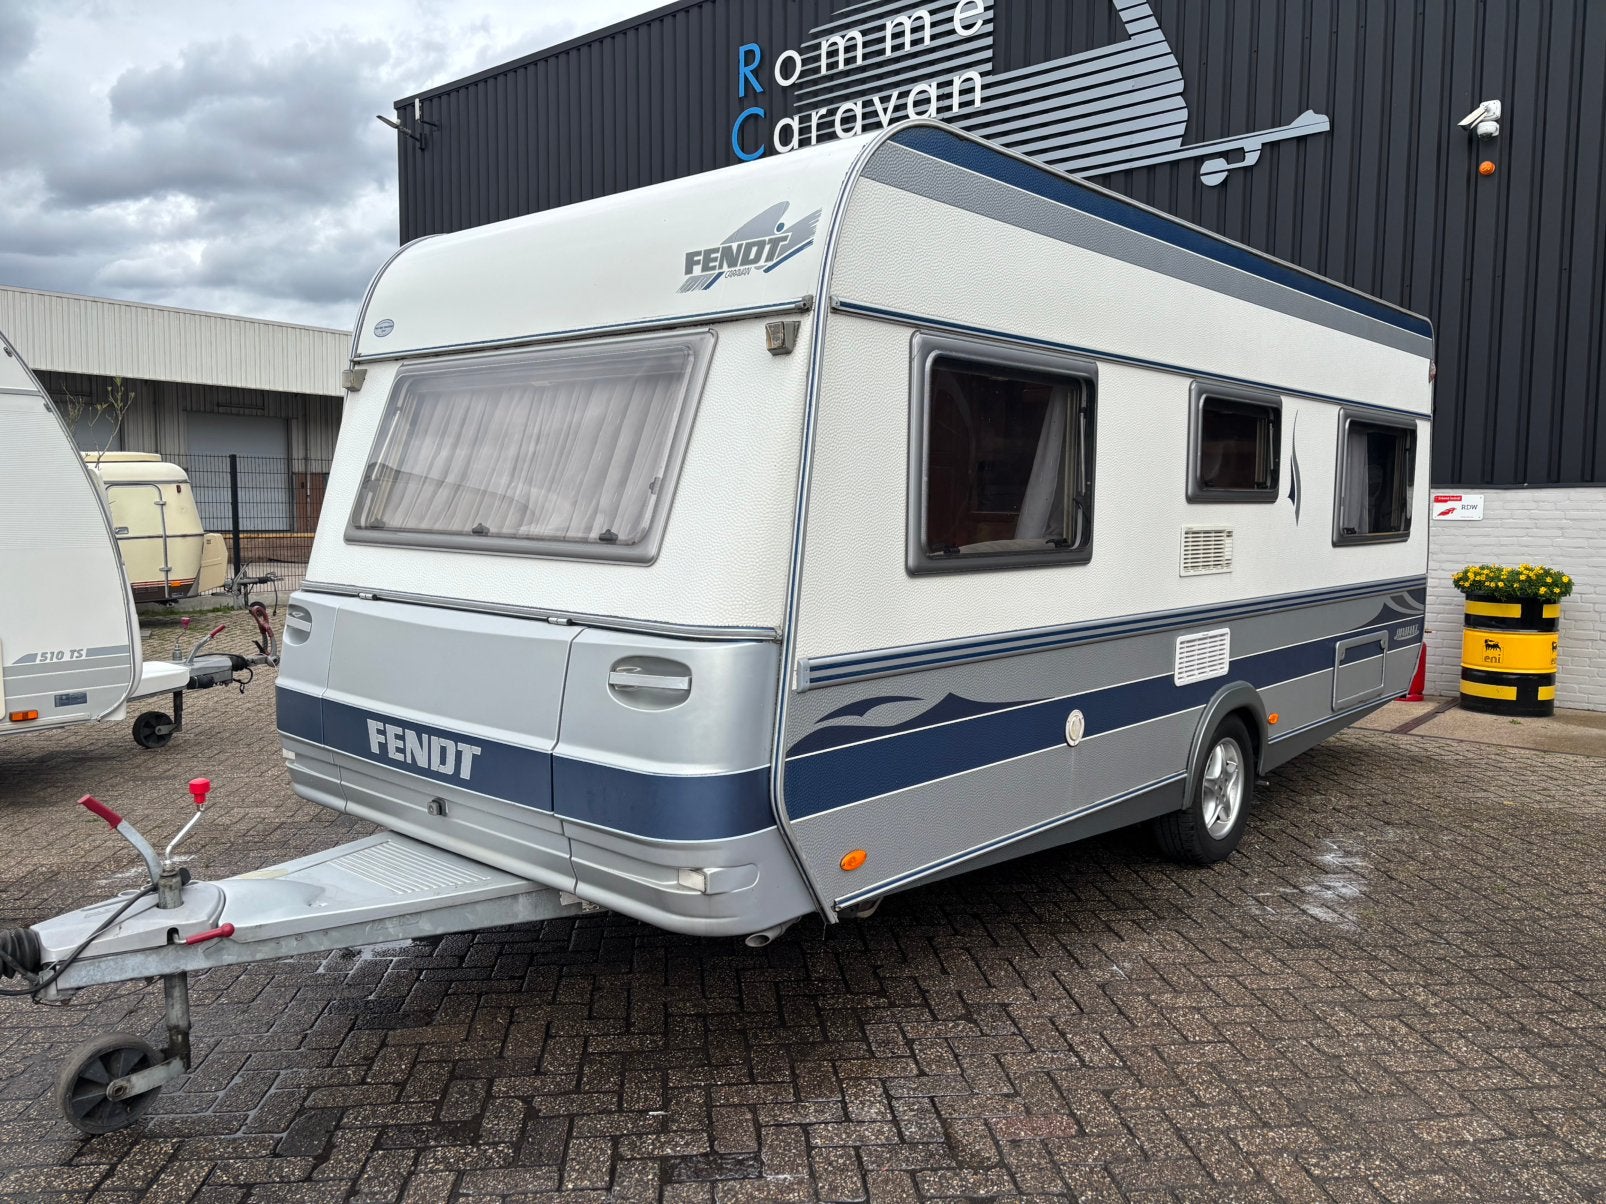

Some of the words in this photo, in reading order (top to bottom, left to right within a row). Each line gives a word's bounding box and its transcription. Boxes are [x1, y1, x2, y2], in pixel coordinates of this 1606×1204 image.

[738, 0, 985, 98] Romme
[731, 70, 982, 161] Caravan
[684, 233, 791, 276] FENDT
[39, 651, 65, 662] 510
[69, 648, 84, 659] TS
[1484, 653, 1501, 663] eni
[366, 718, 482, 780] FENDT
